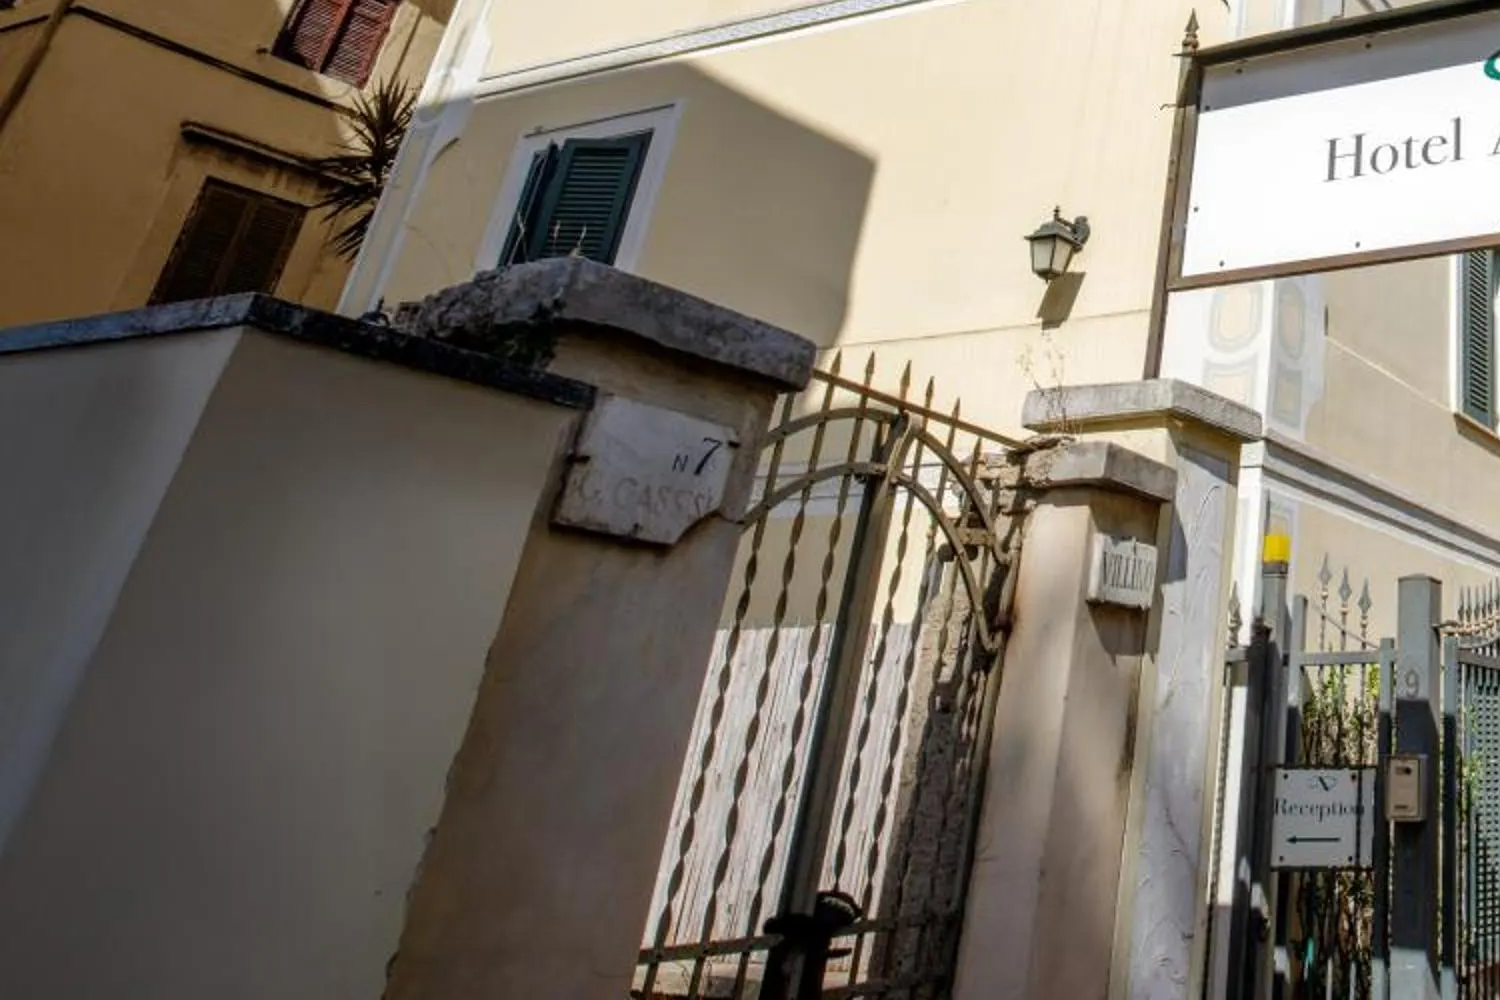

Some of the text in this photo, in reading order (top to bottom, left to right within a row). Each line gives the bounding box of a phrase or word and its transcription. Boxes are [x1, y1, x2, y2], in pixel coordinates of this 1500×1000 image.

[1322, 115, 1464, 183] Hotel
[693, 436, 724, 477] 7
[1274, 798, 1365, 823] Reception
